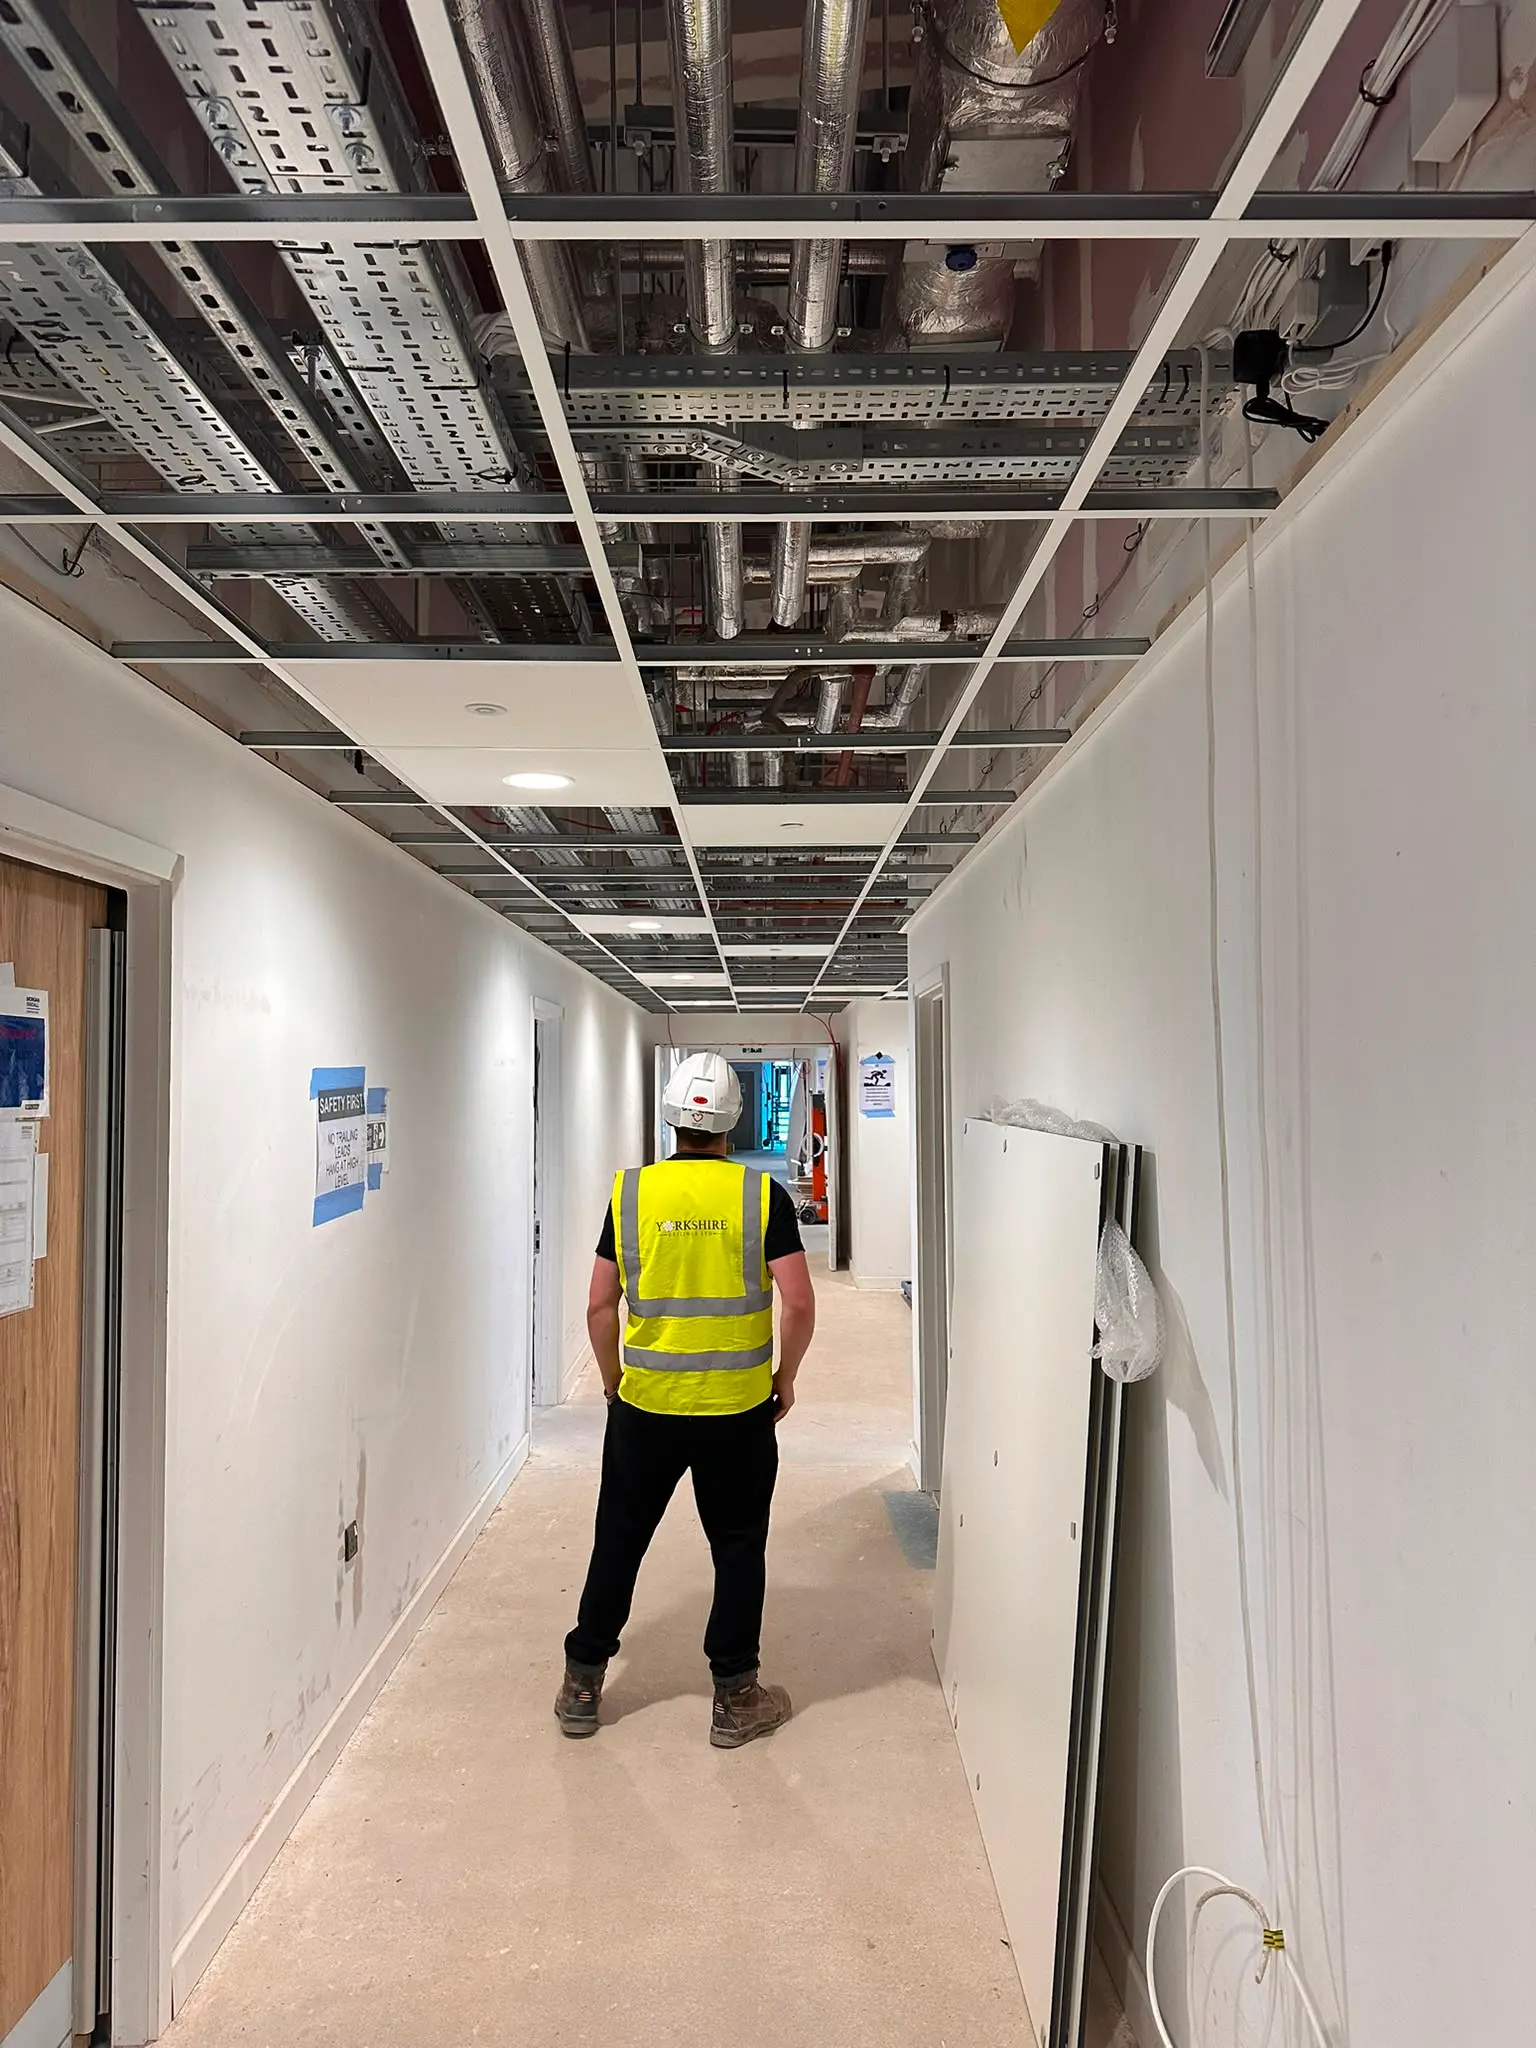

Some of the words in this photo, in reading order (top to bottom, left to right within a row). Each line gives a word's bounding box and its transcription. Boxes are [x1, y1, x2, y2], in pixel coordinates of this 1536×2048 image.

[320, 1096, 345, 1114] SAFETY
[346, 1094, 363, 1112] FIRST
[328, 1132, 335, 1145] NO
[336, 1128, 358, 1144] TRAILING
[335, 1144, 351, 1159] LEADS
[326, 1161, 340, 1176] HANG
[340, 1159, 347, 1171] AT
[347, 1156, 359, 1170] HIGH
[335, 1173, 350, 1189] LEVEL
